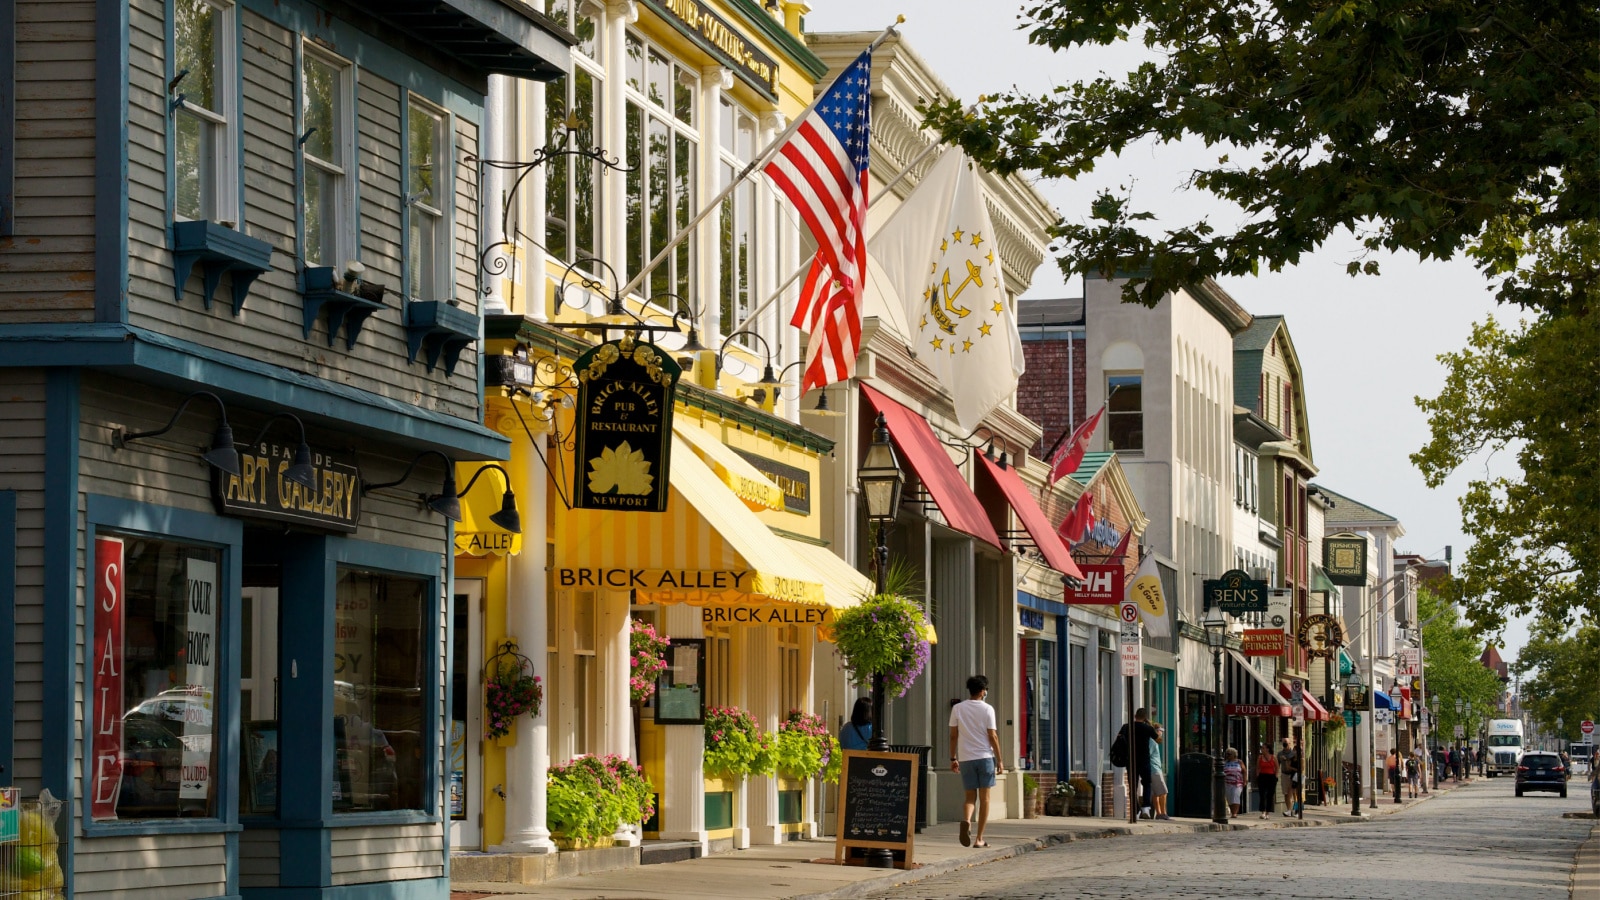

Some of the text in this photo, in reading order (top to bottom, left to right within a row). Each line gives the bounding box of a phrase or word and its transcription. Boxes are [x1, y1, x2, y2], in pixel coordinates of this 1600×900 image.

[703, 13, 745, 65] COCKTAILS
[592, 381, 659, 417] BRICK ALLEY
[614, 402, 635, 411] PUB
[620, 412, 629, 420] &
[591, 421, 657, 433] RESTAURANT
[260, 442, 332, 468] SEADE
[227, 453, 356, 520] ART GALLERY
[592, 496, 648, 506] NEWPORT
[469, 533, 514, 549] ALLEY
[560, 569, 748, 588] BRICK ALLEY
[1137, 582, 1158, 611] is Good
[1150, 584, 1160, 602] Life
[1214, 589, 1259, 602] BEN'S
[703, 608, 829, 623] BRICK ALLEY
[1245, 633, 1283, 641] NEWPORT
[187, 631, 210, 666] HOICE
[1245, 642, 1283, 650] FUDGERY
[95, 562, 118, 805] SALE
[1235, 706, 1270, 714] FUDGE
[182, 765, 208, 782] CLUDED
